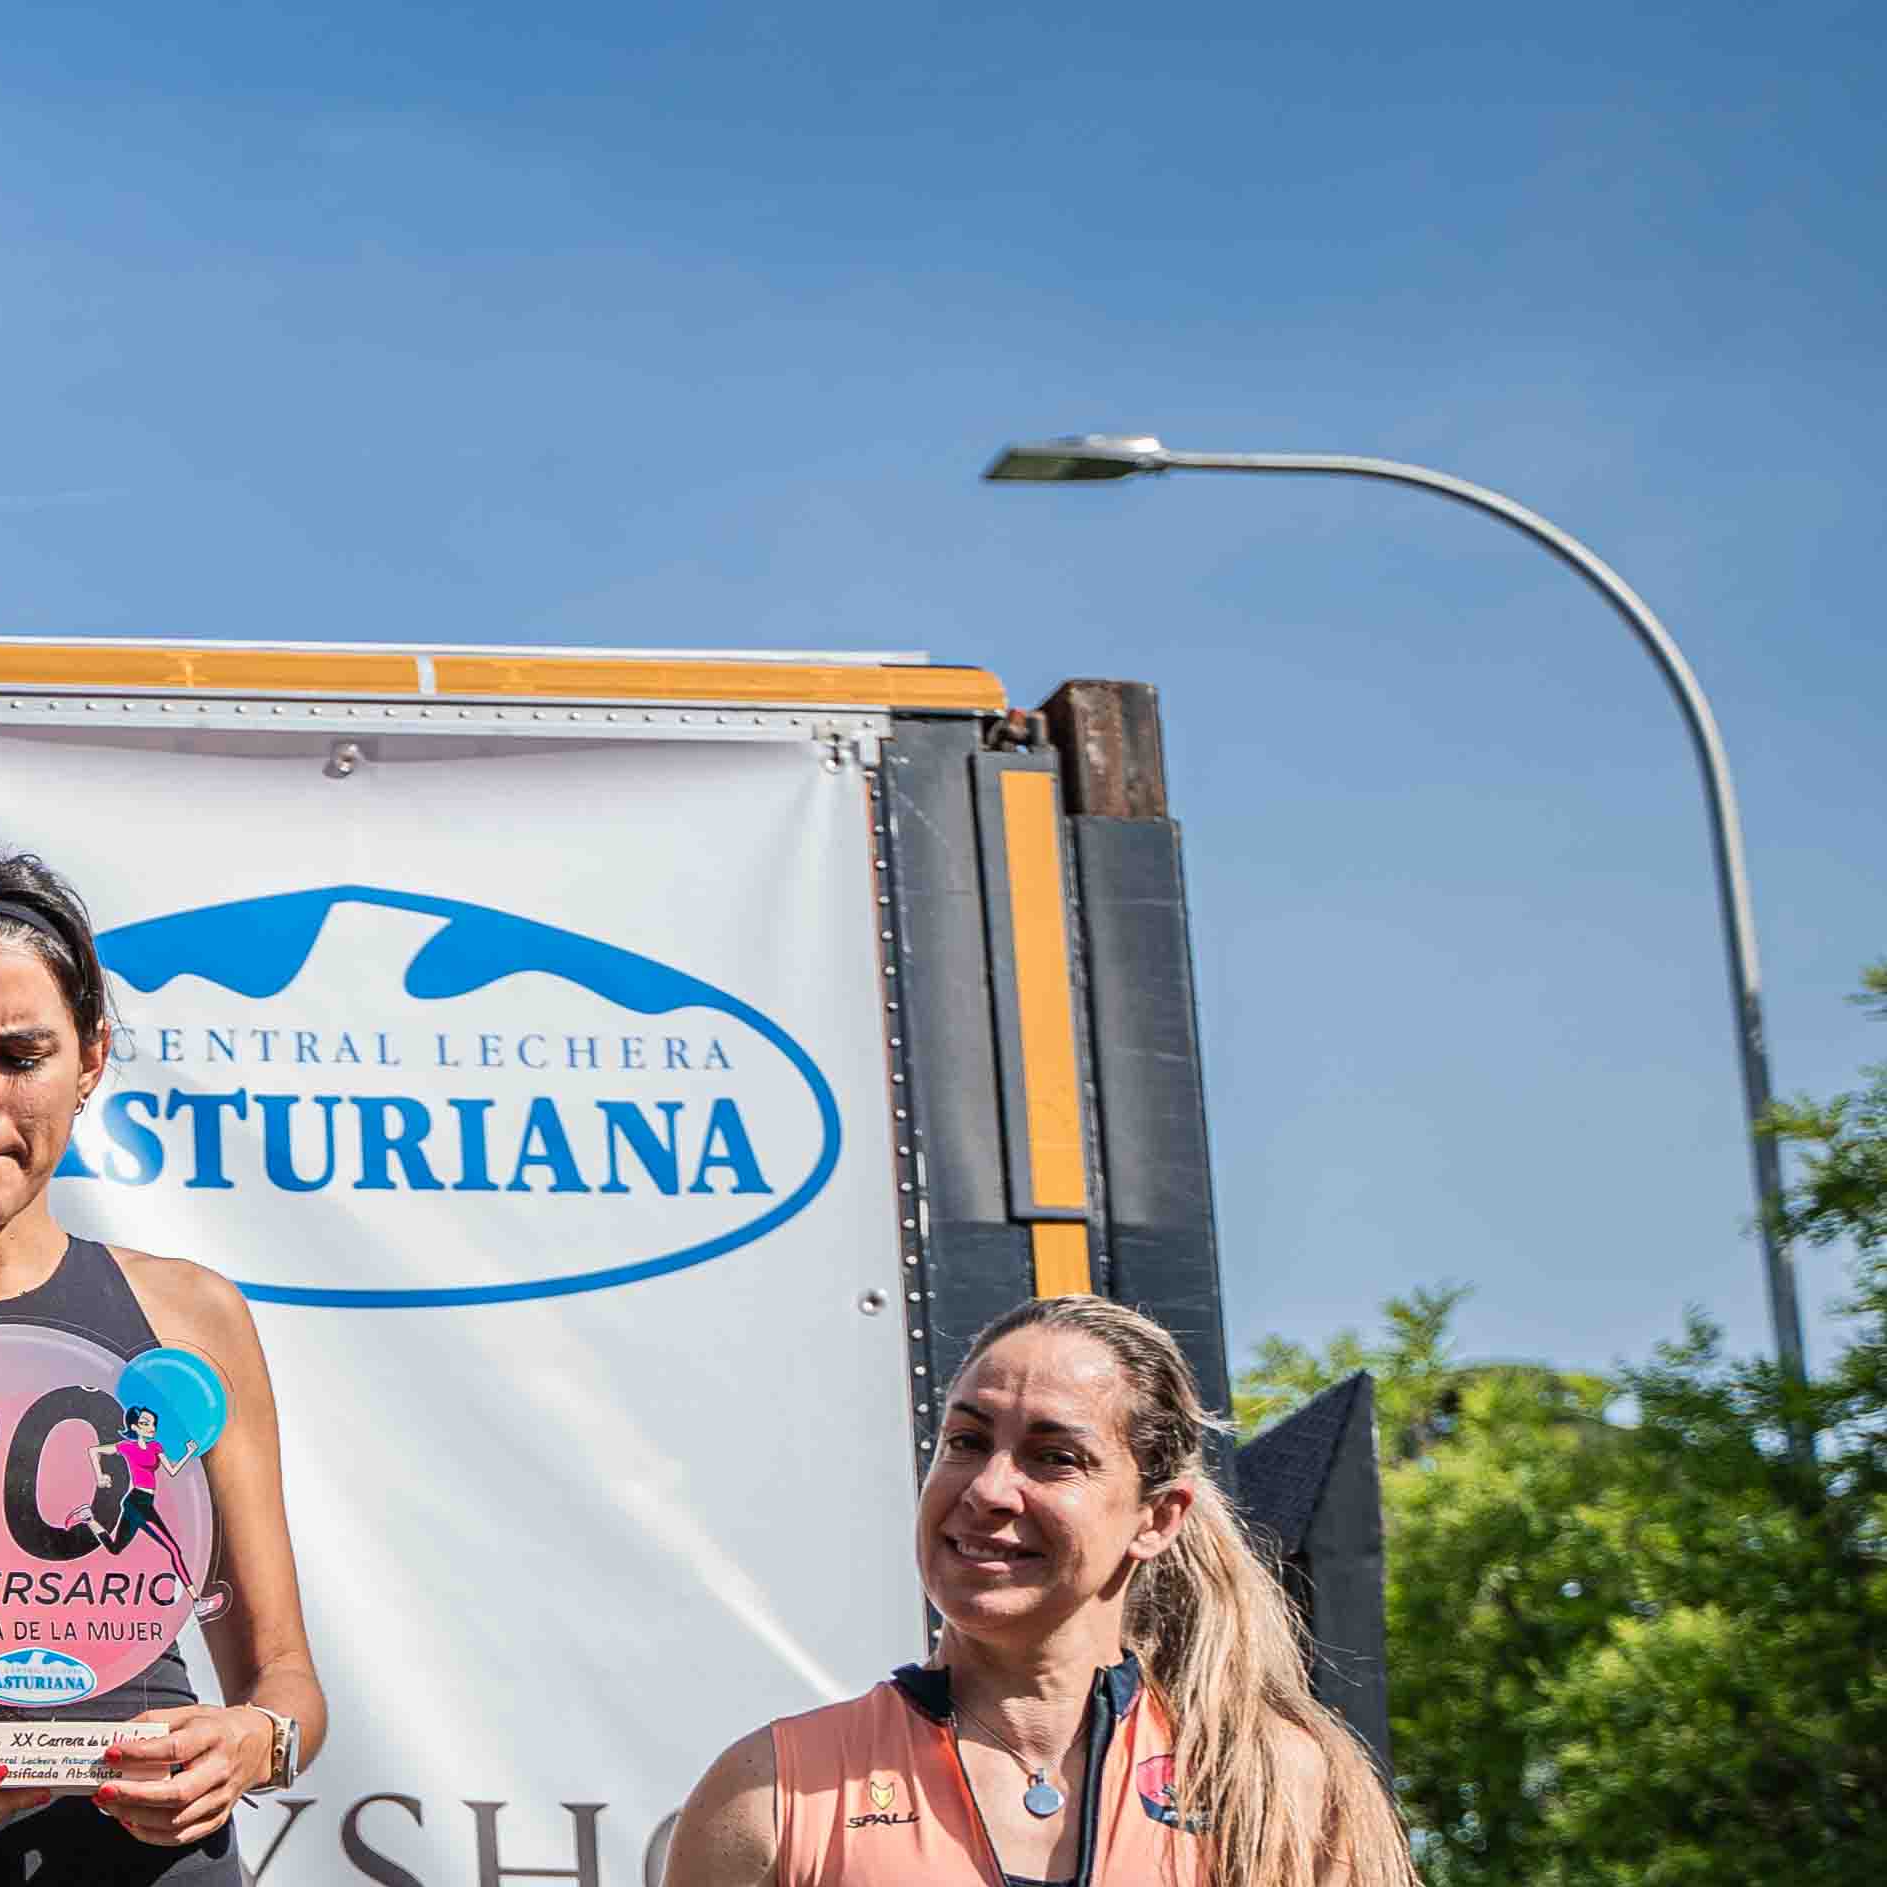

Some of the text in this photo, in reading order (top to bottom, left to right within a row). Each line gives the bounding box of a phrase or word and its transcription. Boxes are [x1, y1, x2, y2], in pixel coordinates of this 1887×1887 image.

[111, 1028, 733, 1071] CENTRAL LECHERA
[52, 1086, 774, 1196] STURIANA
[14, 1621, 40, 1641] DE
[51, 1621, 77, 1641] LA
[87, 1620, 164, 1642] MUJER
[10, 1733, 33, 1746] XX
[37, 1733, 84, 1747] Carrera
[87, 1735, 98, 1746] de
[66, 1767, 123, 1779] Absoluta
